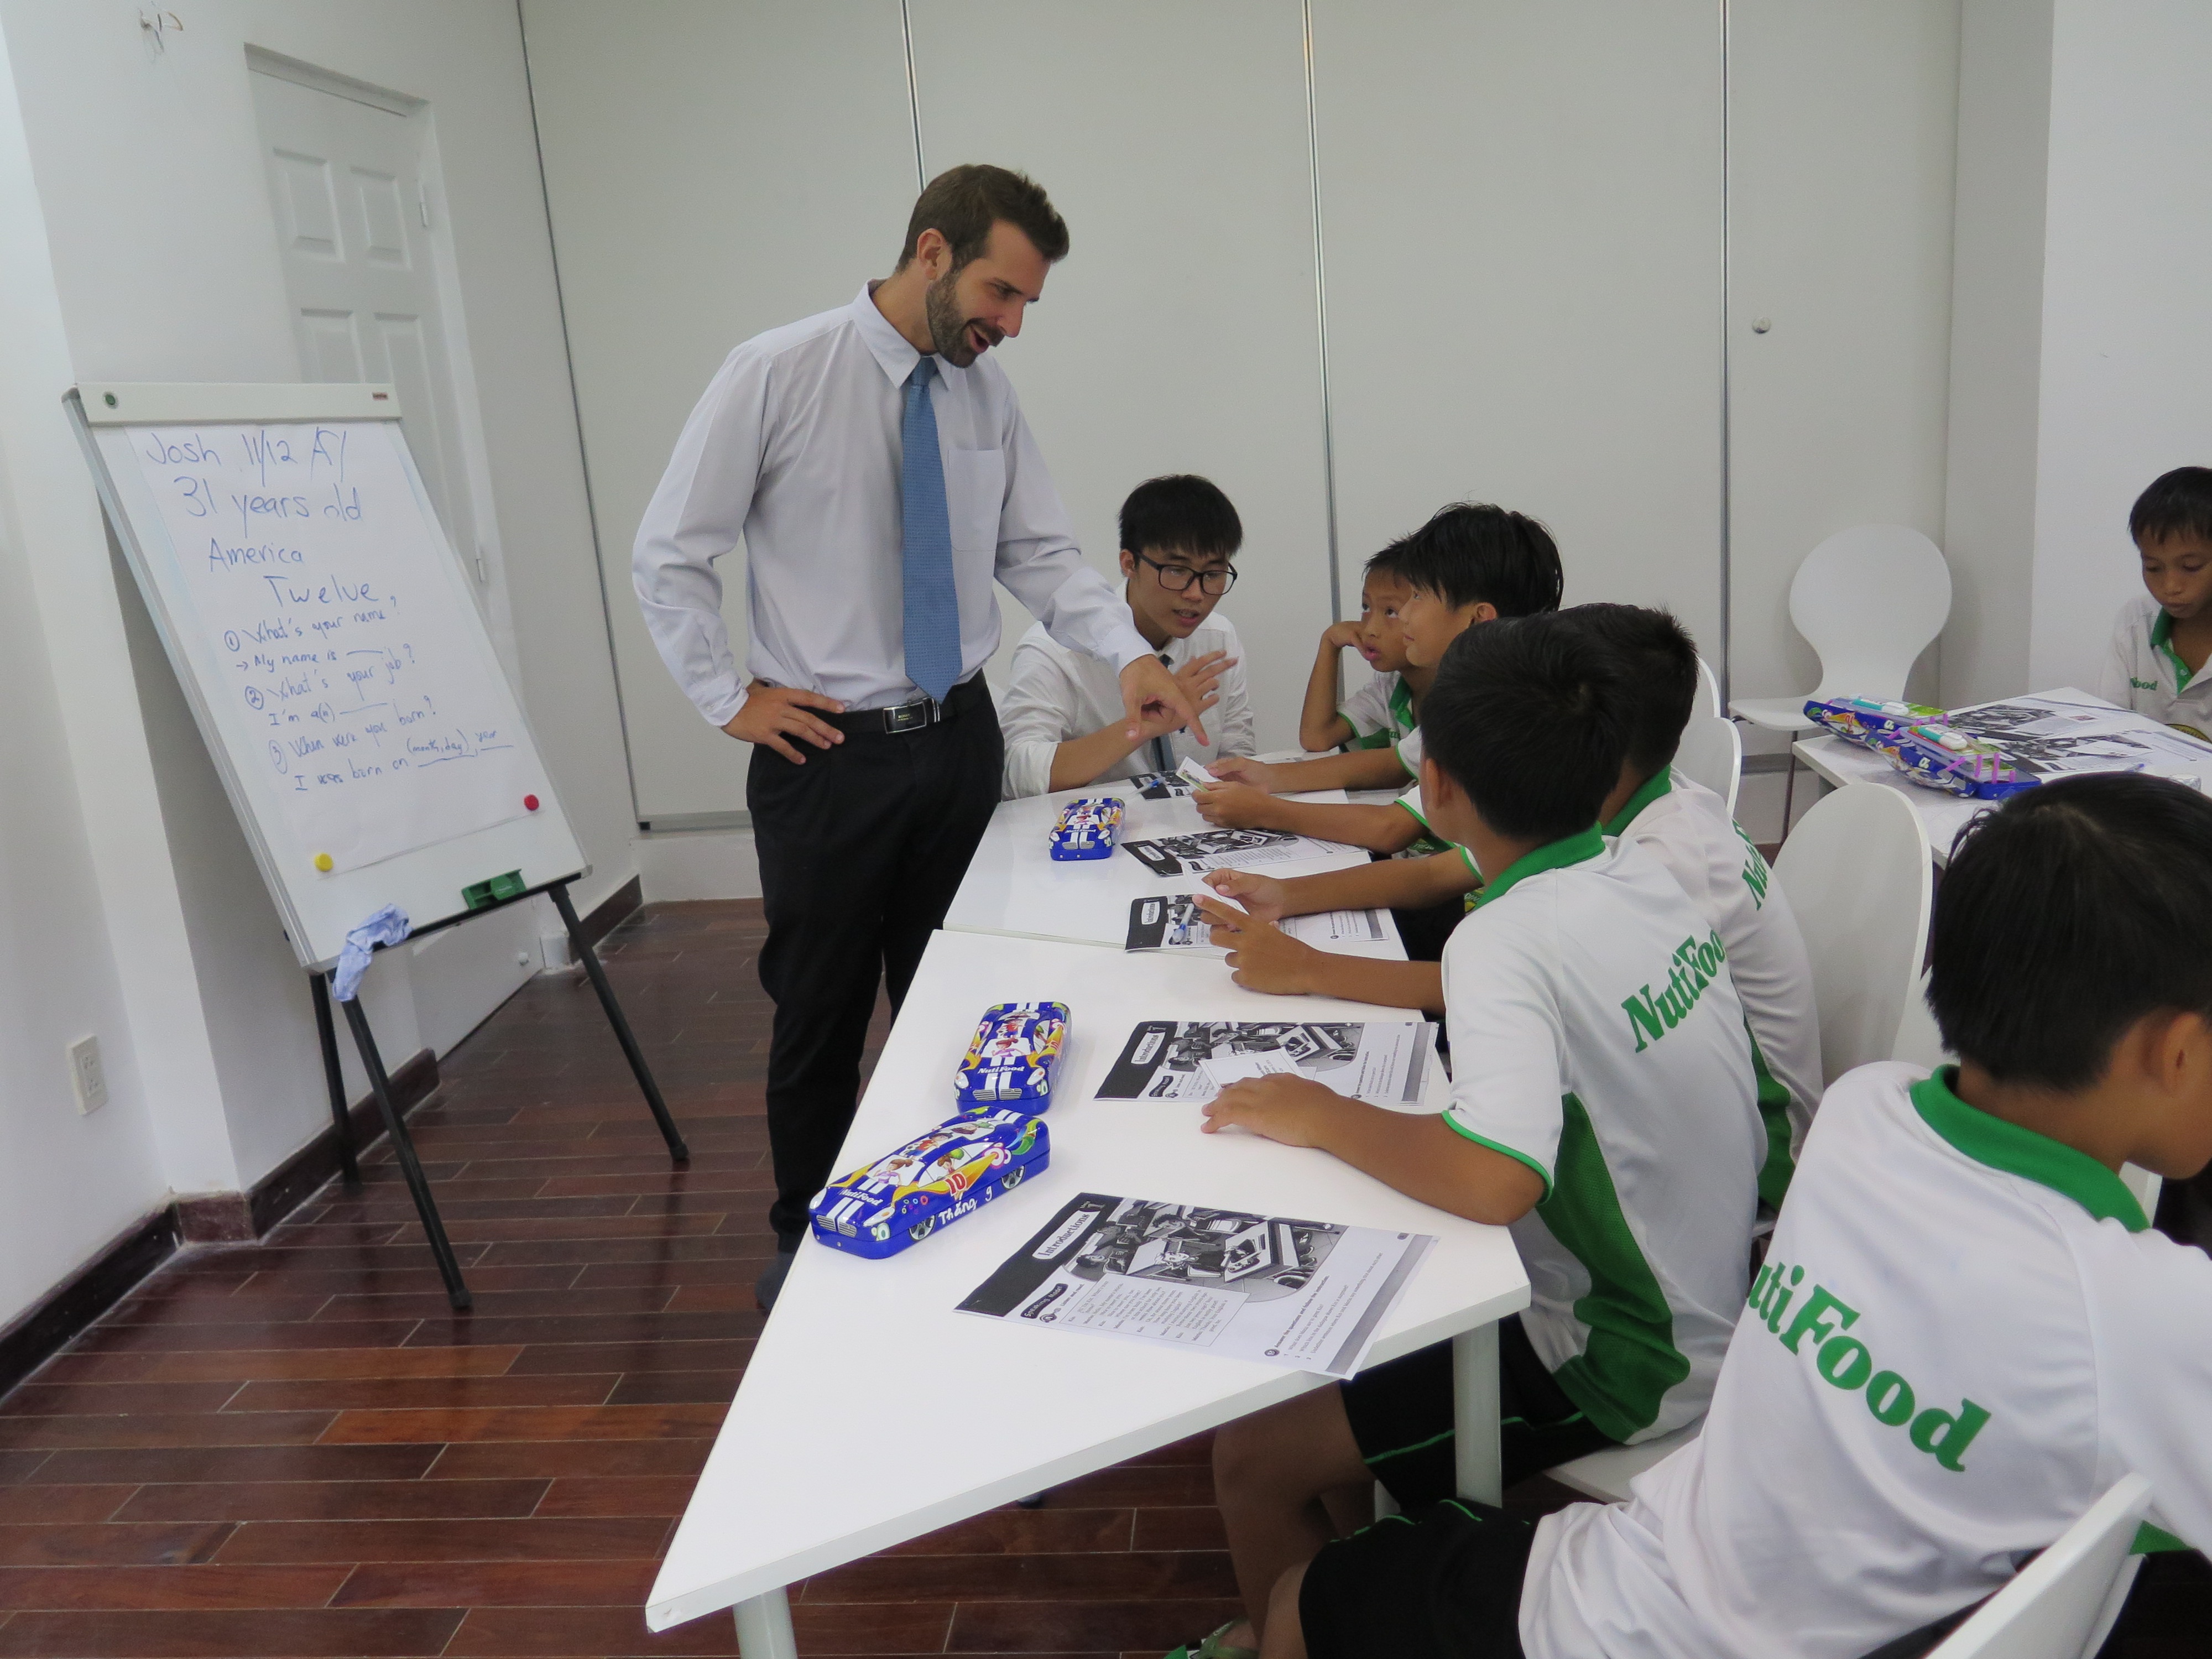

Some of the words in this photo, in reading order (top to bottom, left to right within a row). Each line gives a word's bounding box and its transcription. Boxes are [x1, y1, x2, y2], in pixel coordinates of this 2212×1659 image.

[146, 432, 221, 465] Josh
[173, 476, 218, 517] 31
[231, 494, 310, 540] years
[324, 483, 363, 522] old
[208, 537, 304, 572] America
[311, 615, 343, 640] your
[253, 654, 275, 673] My
[281, 653, 319, 665] name
[326, 650, 337, 662] is
[346, 665, 375, 702] your
[268, 708, 300, 727] I'm
[288, 735, 325, 759] When
[347, 758, 383, 780] born
[392, 757, 409, 770] on
[1620, 928, 1726, 1053] NutiFoo
[977, 1066, 1025, 1074] NutiFood
[1037, 1214, 1090, 1256] Introductions
